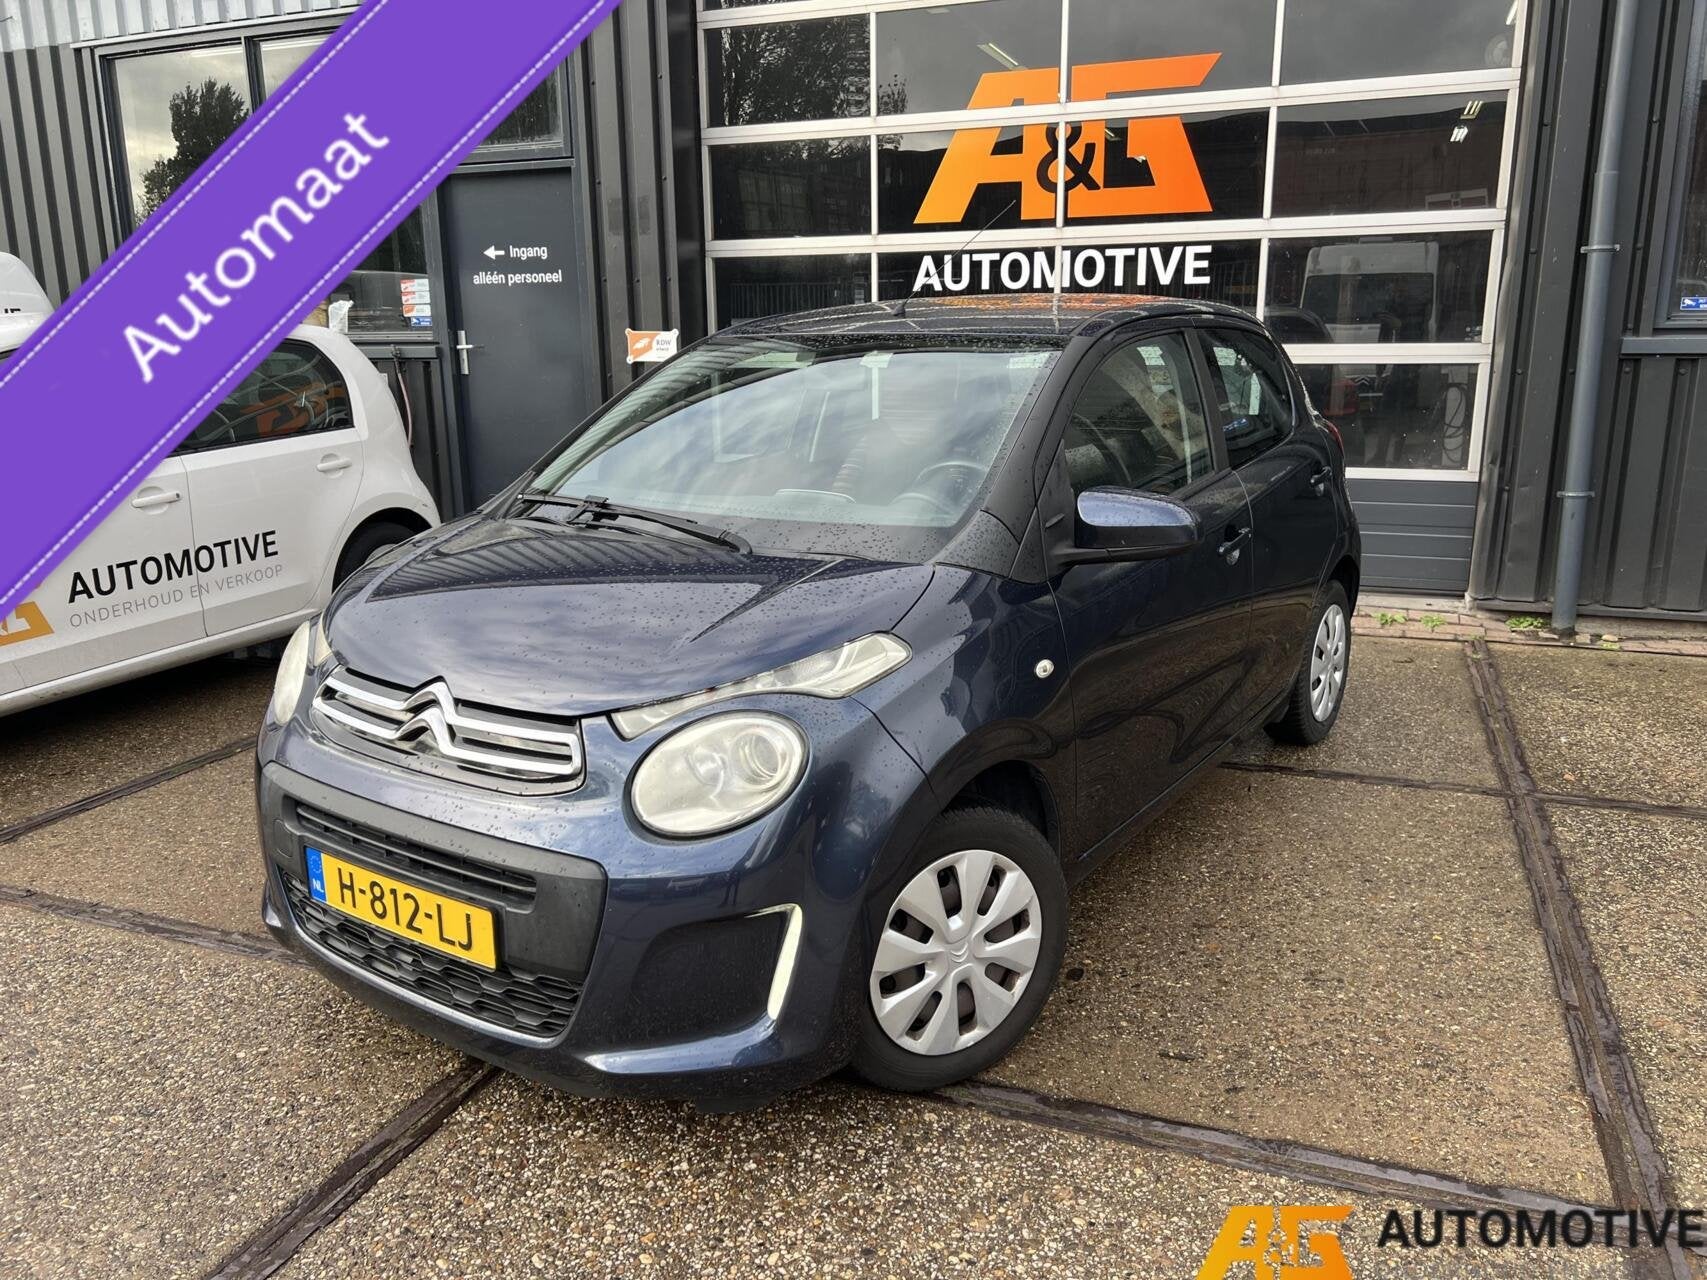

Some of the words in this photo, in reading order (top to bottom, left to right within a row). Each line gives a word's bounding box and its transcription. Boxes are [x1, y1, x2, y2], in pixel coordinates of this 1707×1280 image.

[912, 52, 1223, 225] A&G
[472, 270, 506, 285] alléén
[507, 268, 563, 287] personeel
[509, 244, 548, 261] Ingang
[912, 244, 1213, 293] AUTOMOTIVE
[67, 529, 280, 604] AUTOMOTIVE
[69, 589, 185, 629] ONDERHOUD
[190, 582, 211, 599] EN
[215, 563, 284, 593] VERKOOP
[312, 877, 325, 894] NL
[337, 867, 474, 951] H-812-LJ
